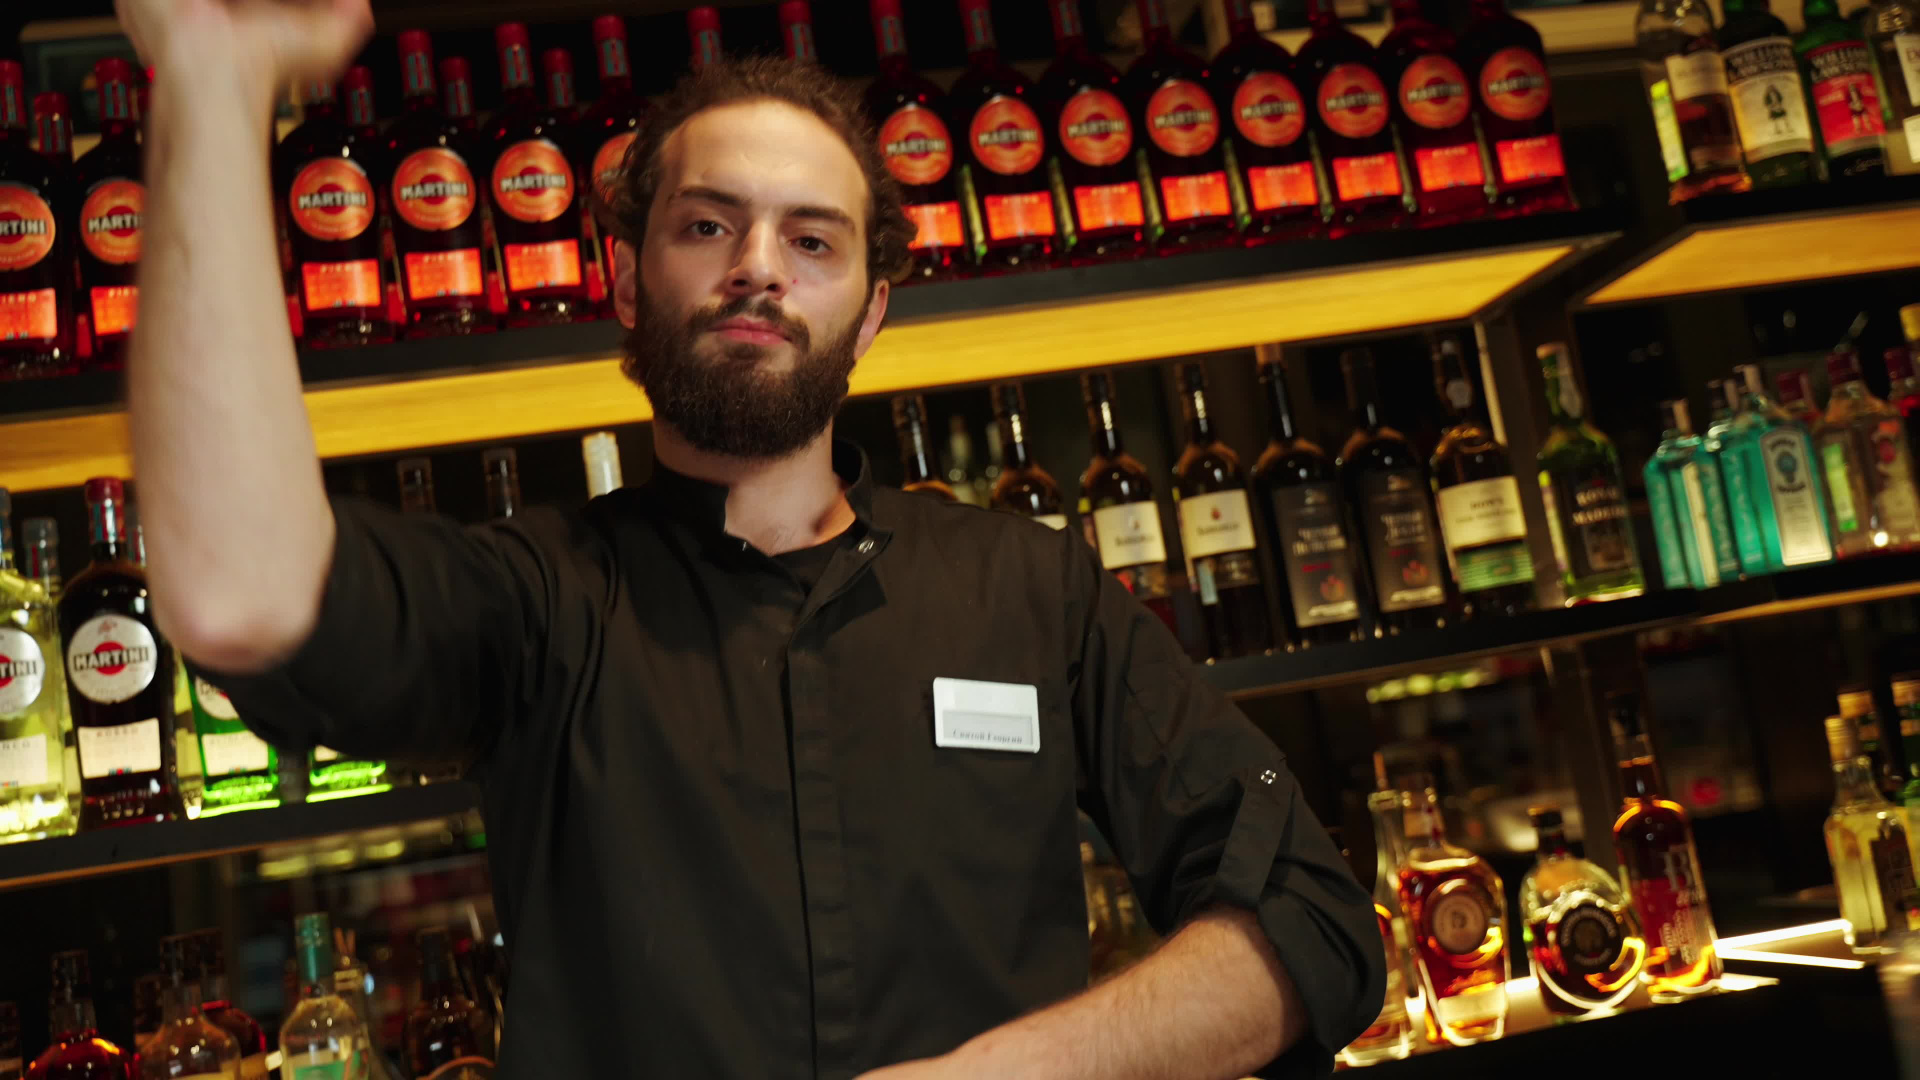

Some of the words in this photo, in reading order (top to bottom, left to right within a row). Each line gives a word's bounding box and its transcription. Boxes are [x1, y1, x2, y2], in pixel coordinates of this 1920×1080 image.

[1154, 109, 1213, 128] MARTINI
[978, 128, 1038, 146] MARTINI
[1068, 119, 1126, 137] MARTINI
[886, 139, 947, 156] MARTINI
[401, 181, 468, 200] MARTINI
[501, 173, 566, 192] MARTINI
[298, 191, 367, 209] MARTINI
[0, 219, 47, 236] RTINI
[88, 214, 141, 233] MARTI
[73, 647, 149, 672] MARTINI
[0, 660, 37, 678] TINI
